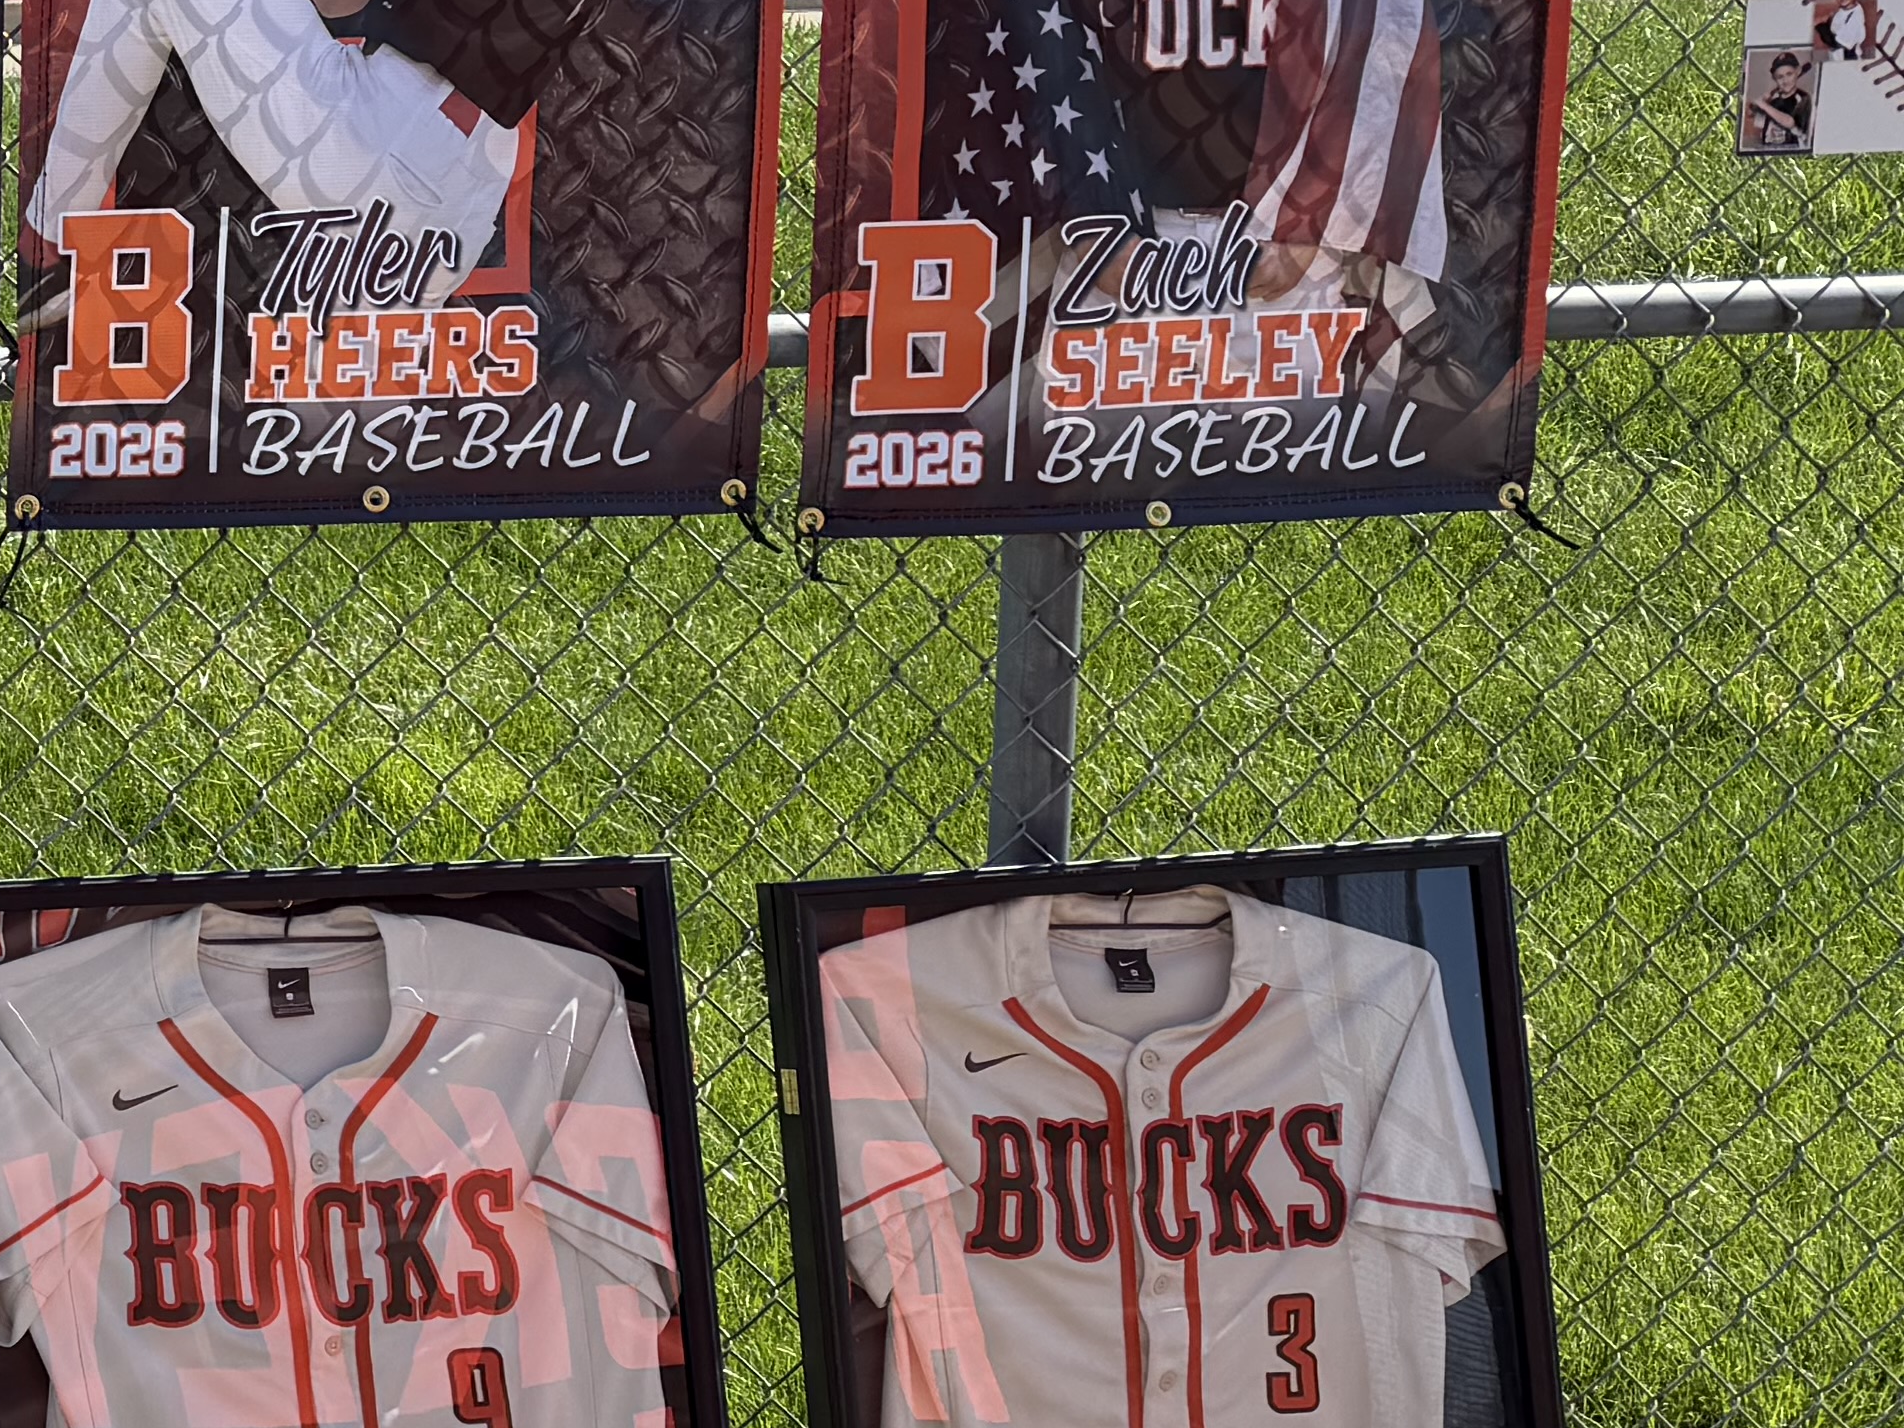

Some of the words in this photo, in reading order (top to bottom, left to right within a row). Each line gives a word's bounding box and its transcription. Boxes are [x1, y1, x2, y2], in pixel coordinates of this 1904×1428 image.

[53, 208, 195, 407] B
[250, 196, 457, 334] Tyler
[850, 218, 997, 417] B
[1050, 201, 1258, 326] Zach
[244, 304, 539, 404] HEERS
[1043, 308, 1367, 412] SEELEY
[49, 421, 186, 478] 2026
[242, 399, 651, 477] BASEBALL
[844, 430, 985, 489] 2026
[1038, 401, 1427, 484] BASEBALL
[963, 1103, 1348, 1262] BUCKS
[119, 1167, 520, 1330] BUCKS
[1265, 1292, 1320, 1414] 3
